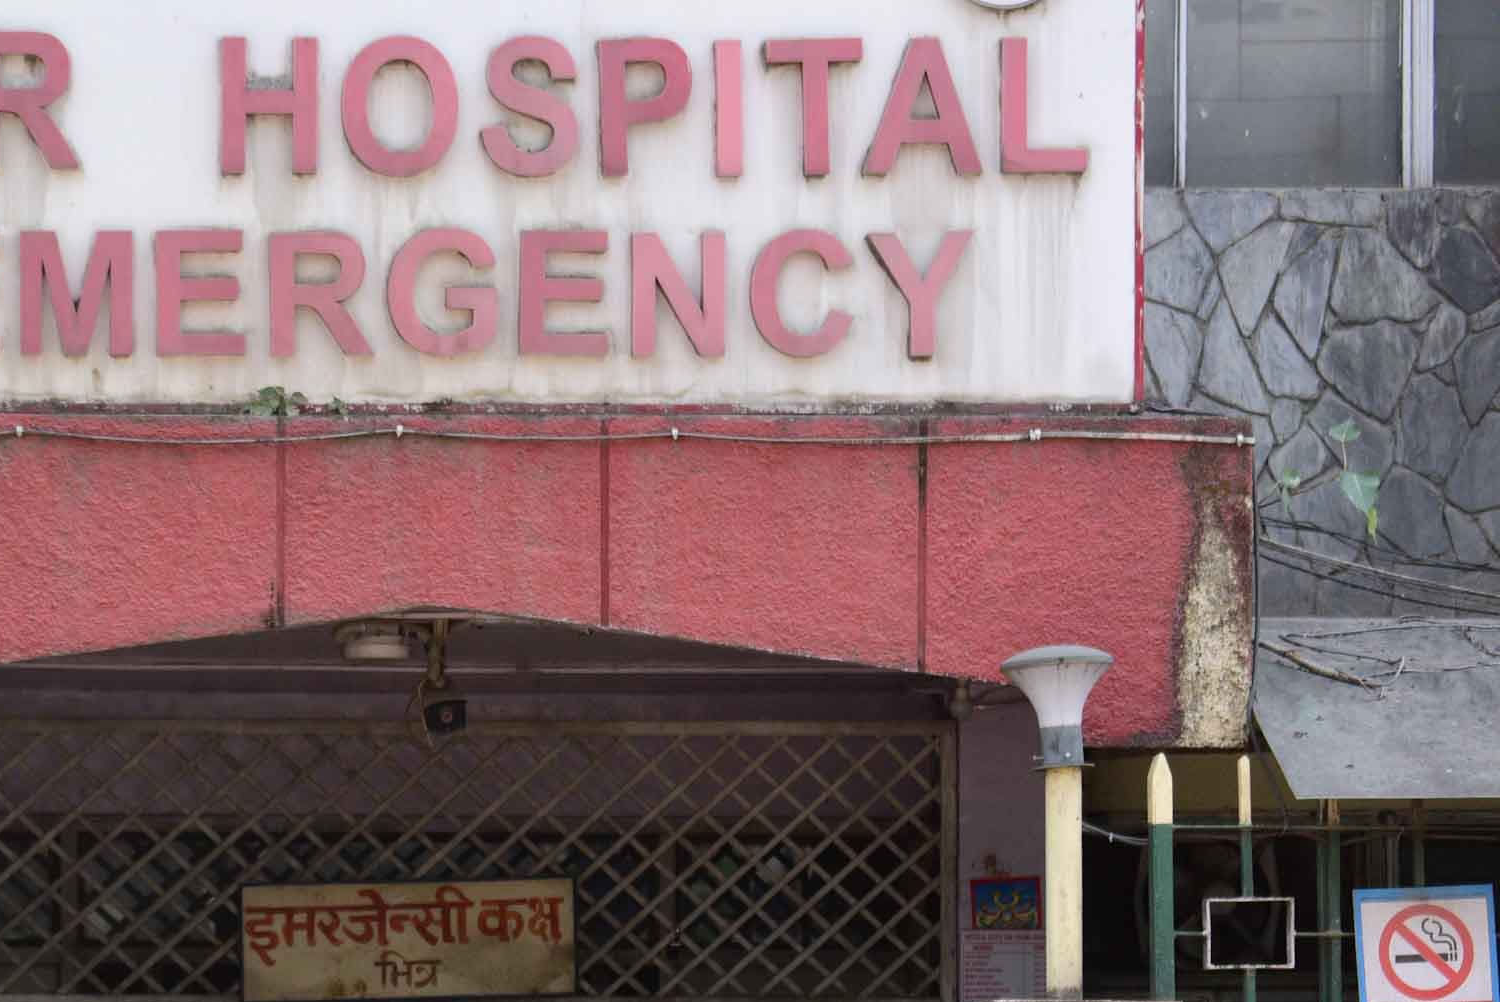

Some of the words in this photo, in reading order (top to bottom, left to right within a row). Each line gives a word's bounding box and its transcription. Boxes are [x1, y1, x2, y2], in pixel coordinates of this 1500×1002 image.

[217, 35, 1091, 181] HOSPITAL
[243, 885, 474, 968] इमरजेन्सी
[478, 896, 565, 944] कक्ष
